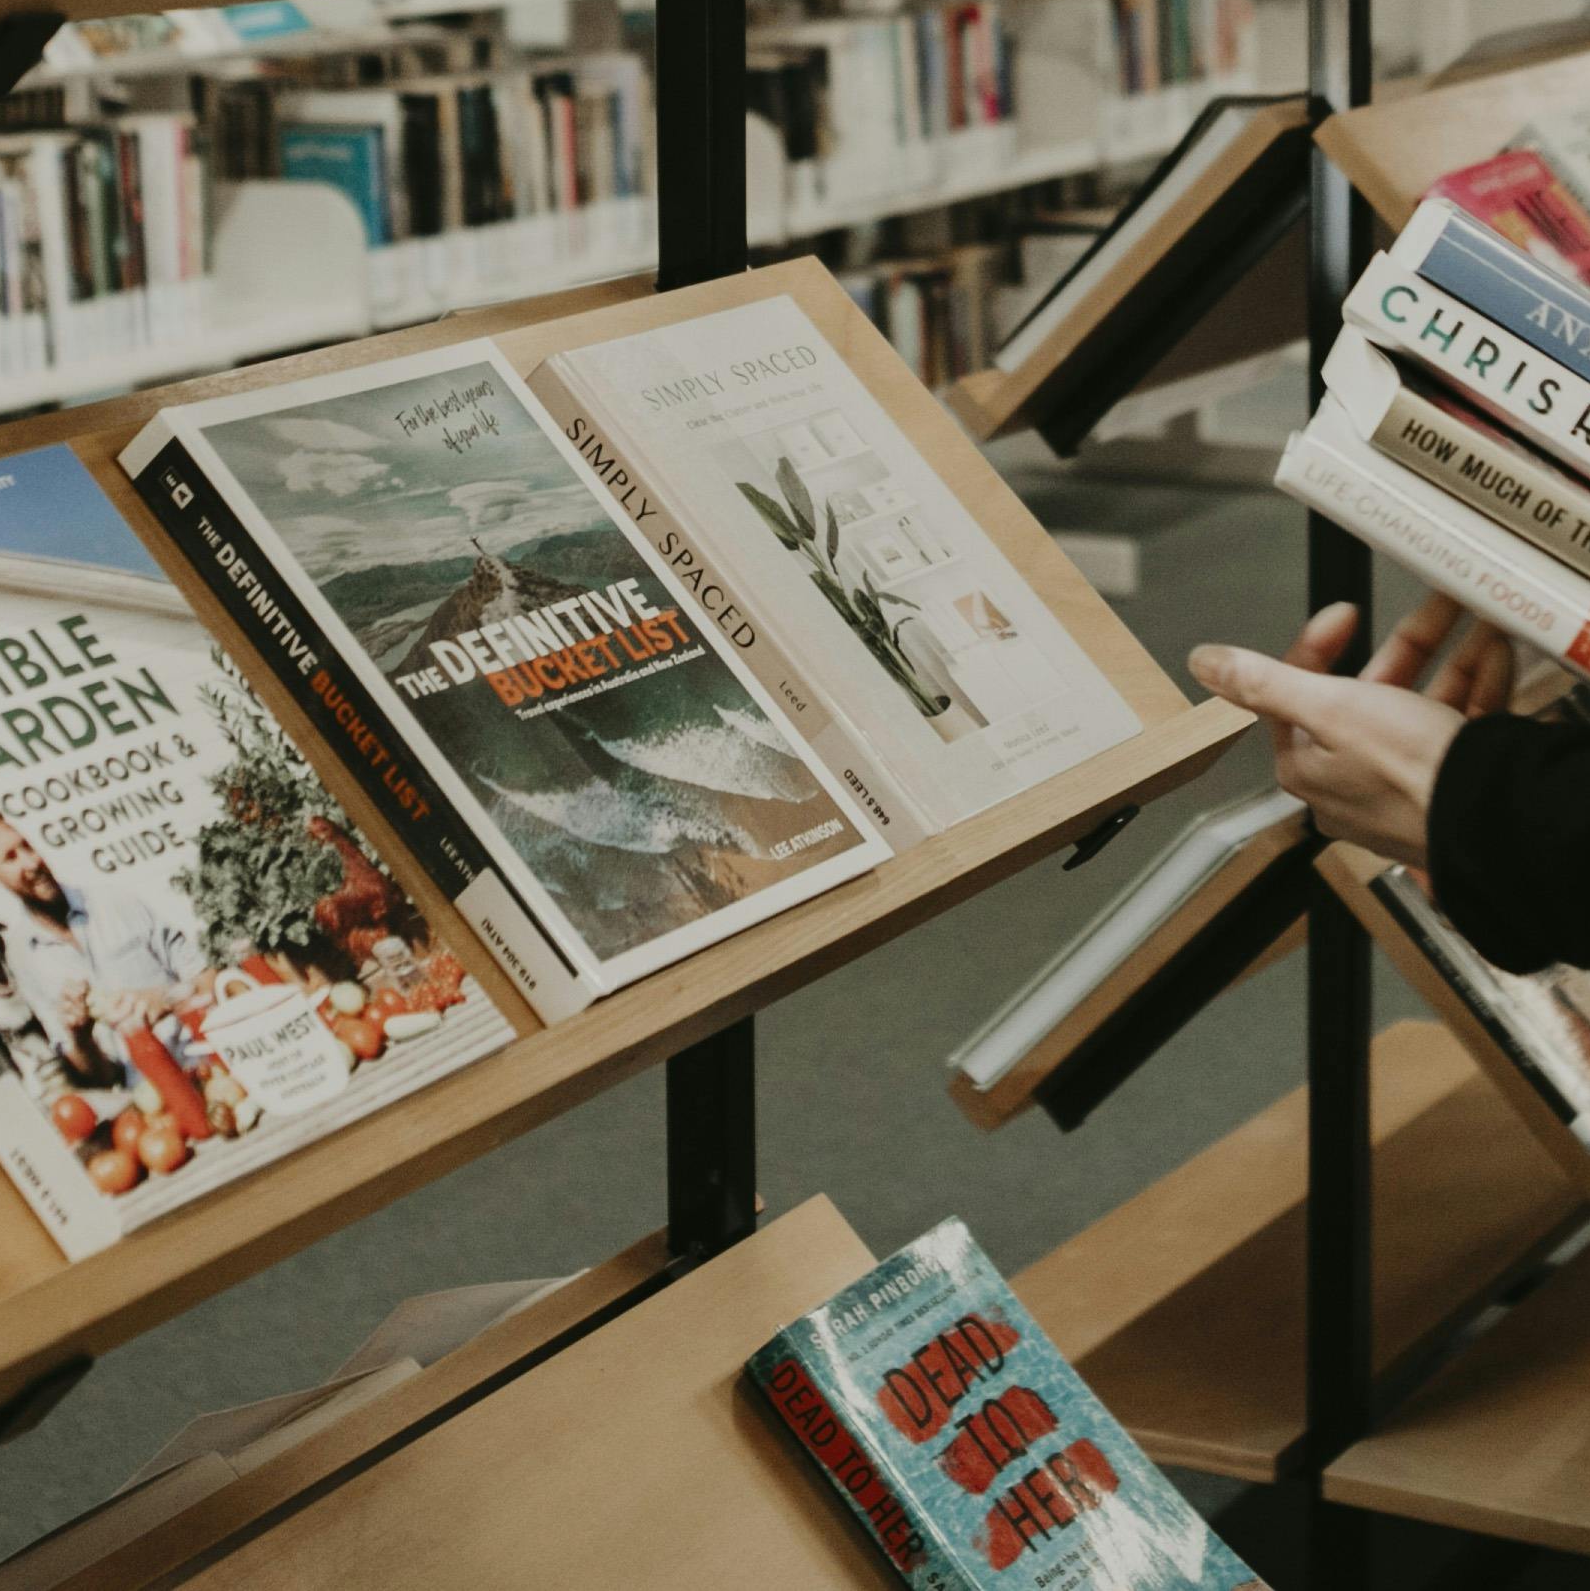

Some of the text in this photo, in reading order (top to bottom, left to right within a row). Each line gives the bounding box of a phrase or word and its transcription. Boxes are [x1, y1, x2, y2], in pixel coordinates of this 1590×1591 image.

[642, 345, 817, 412] SIMPLY SPACED
[1381, 286, 1562, 415] CHRIS
[1401, 418, 1457, 465] HOW
[1460, 452, 1532, 511] MUCH
[1532, 499, 1569, 529] OF
[565, 418, 808, 713] SIMPLY SPACED Leed
[1475, 571, 1558, 634] FOODS
[197, 516, 432, 822] THE DEFINITIVE BUCKET LIST
[396, 577, 660, 700] THE DEFINITIVE
[485, 609, 690, 706] BUCKET LIST
[1, 733, 198, 820] COOKBOOK &
[39, 779, 185, 849] GROWING
[843, 768, 891, 826] 648.5 LEED
[91, 821, 187, 874] GUIDE
[769, 817, 845, 860] LEE ATKINSON
[223, 1035, 274, 1064] PAUL
[809, 1307, 870, 1354] SRAH
[882, 1317, 1005, 1429] DEAD
[769, 1364, 926, 1565] DEAD TO HER
[954, 1398, 1029, 1473] TO
[993, 1452, 1102, 1552] HER
[1033, 1562, 1067, 1589] Being
[1063, 1551, 1082, 1570] the
